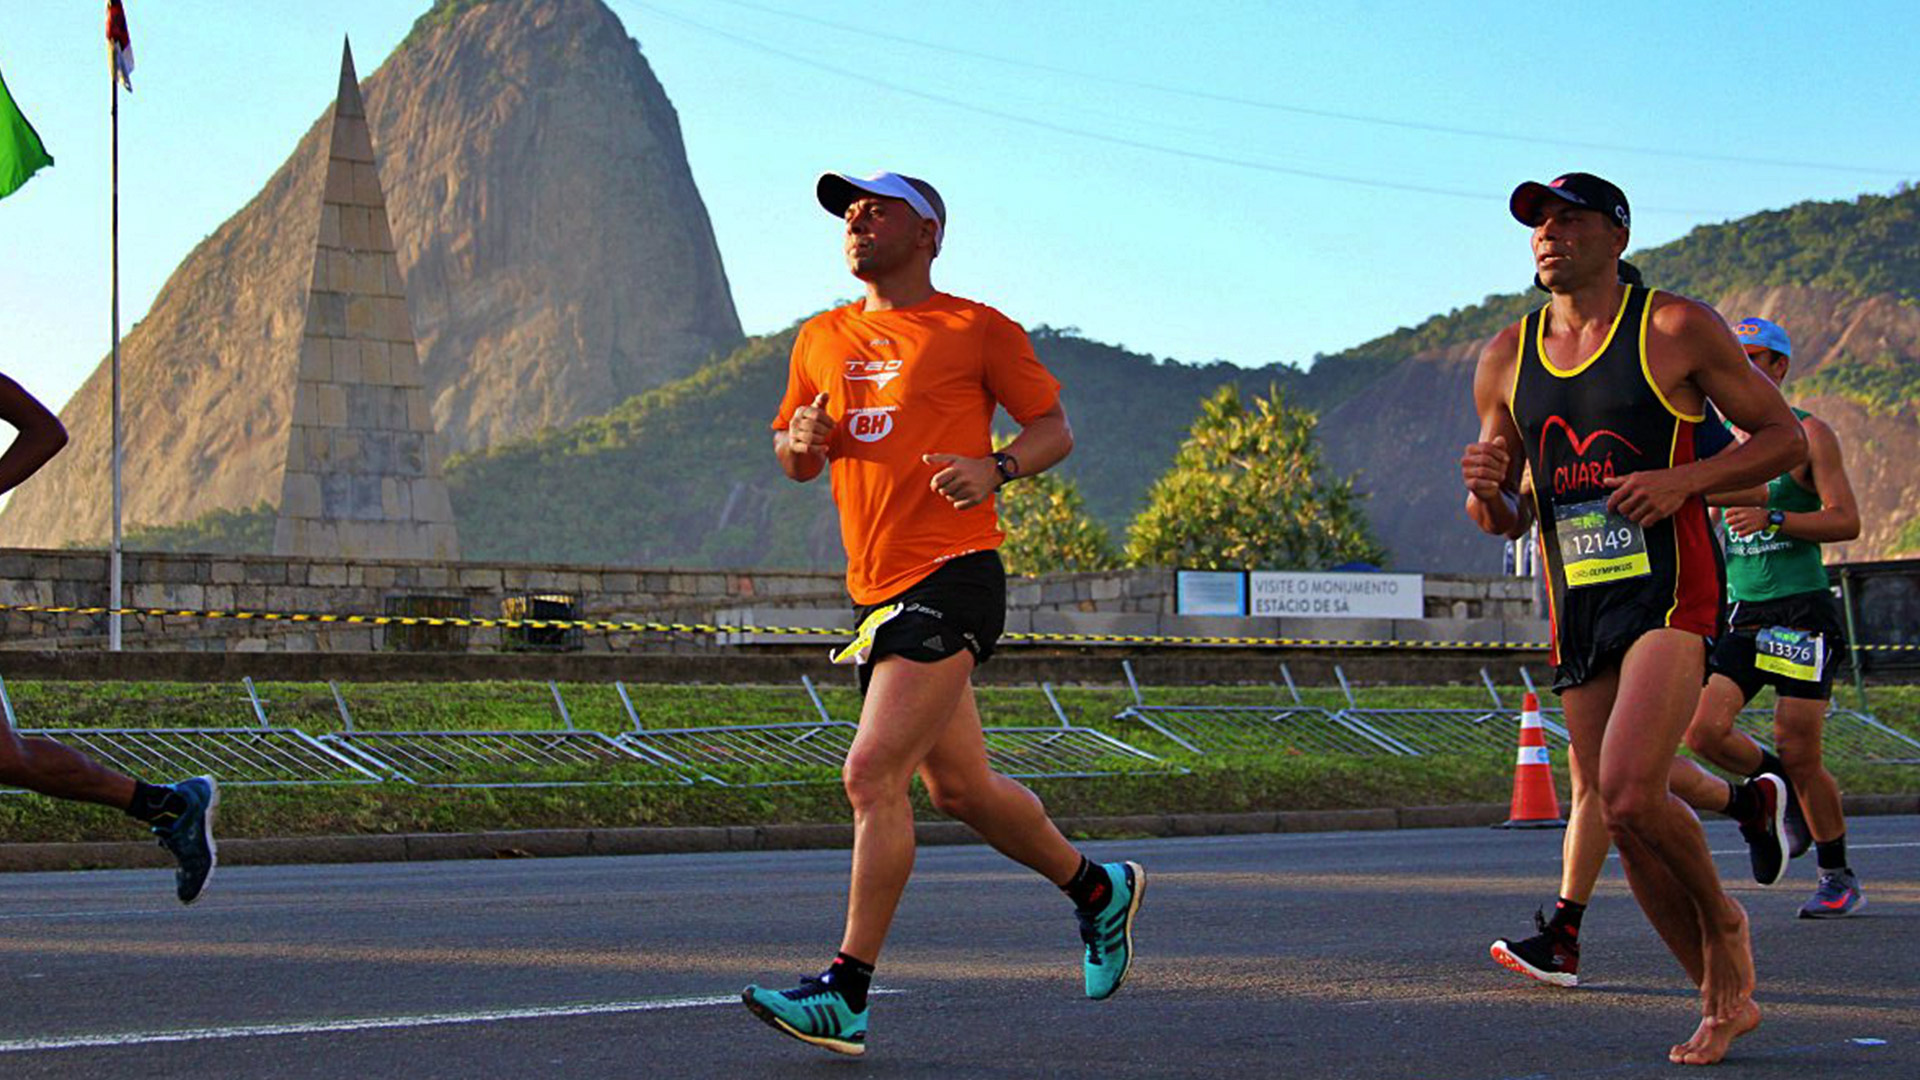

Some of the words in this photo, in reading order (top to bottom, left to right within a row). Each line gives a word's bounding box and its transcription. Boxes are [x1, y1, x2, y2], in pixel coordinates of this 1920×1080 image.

[854, 414, 887, 436] BH
[1572, 527, 1632, 556] 12149
[1255, 579, 1294, 594] VISITE
[1297, 579, 1309, 594] O
[1311, 579, 1399, 596] MONUMENTO
[1256, 595, 1311, 613] ESTÁCIO
[1313, 599, 1330, 613] DE
[1769, 640, 1811, 662] 13376
